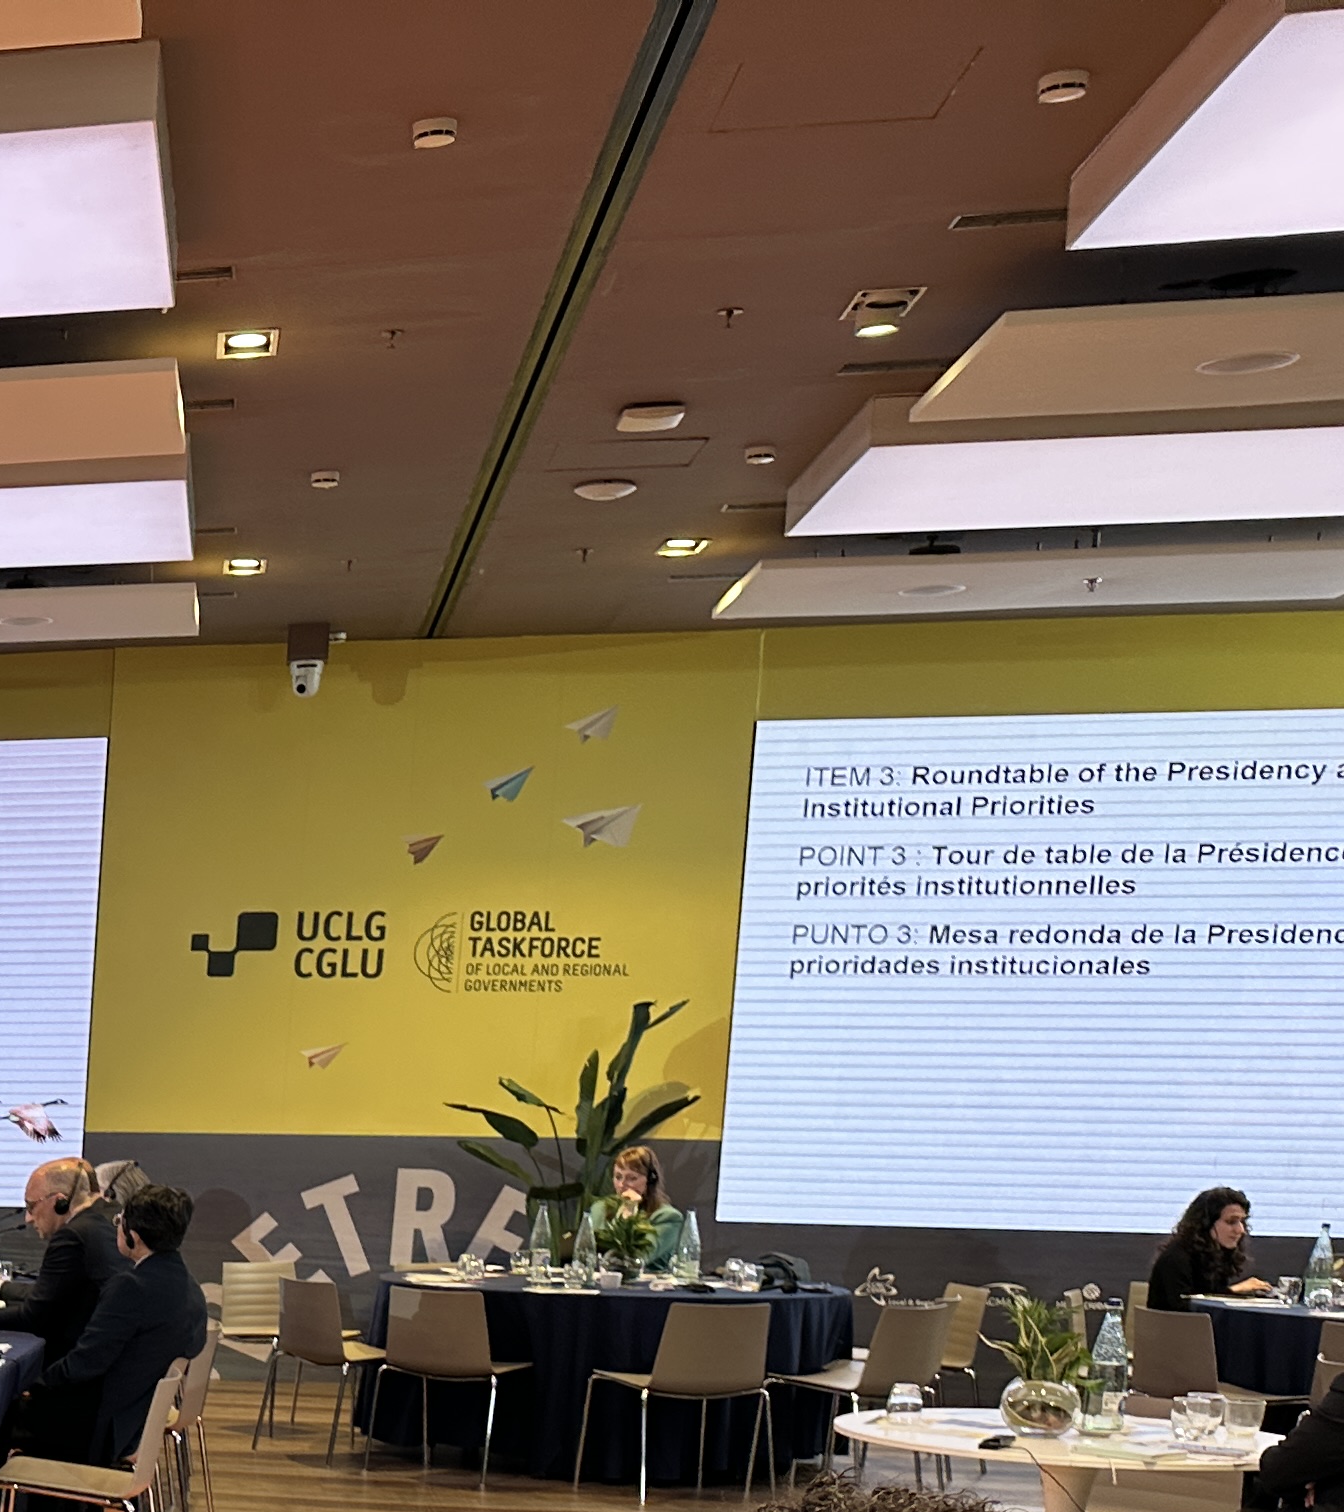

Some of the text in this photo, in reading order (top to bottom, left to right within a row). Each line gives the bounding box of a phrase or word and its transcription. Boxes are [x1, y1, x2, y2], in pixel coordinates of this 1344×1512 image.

[805, 767, 872, 788] ITEM
[879, 766, 901, 787] 3:
[911, 764, 1070, 786] Roundtable
[1078, 762, 1108, 784] of
[1114, 763, 1158, 784] the
[1167, 759, 1327, 787] Presidency
[803, 794, 1095, 818] Institutional Priorities
[799, 845, 885, 867] POINT
[892, 845, 907, 866] 3
[932, 844, 994, 866] Tour
[1003, 844, 1035, 865] de
[1045, 844, 1112, 865] table
[1121, 844, 1153, 865] de
[1164, 844, 1187, 865] la
[796, 874, 1136, 901] priorités institutionnelles
[296, 911, 387, 942] UCLG
[470, 911, 556, 932] GLOBAL
[791, 922, 1344, 945] PUNTO 3: Mesa redonda de la Presidenc
[468, 937, 602, 958] TASKFORCE
[294, 947, 385, 978] CGLU
[465, 963, 629, 977] OF LOCAL AND REGIONAL
[789, 956, 1151, 980] prioridades institucionales
[464, 979, 563, 993] GOVERNMENTS
